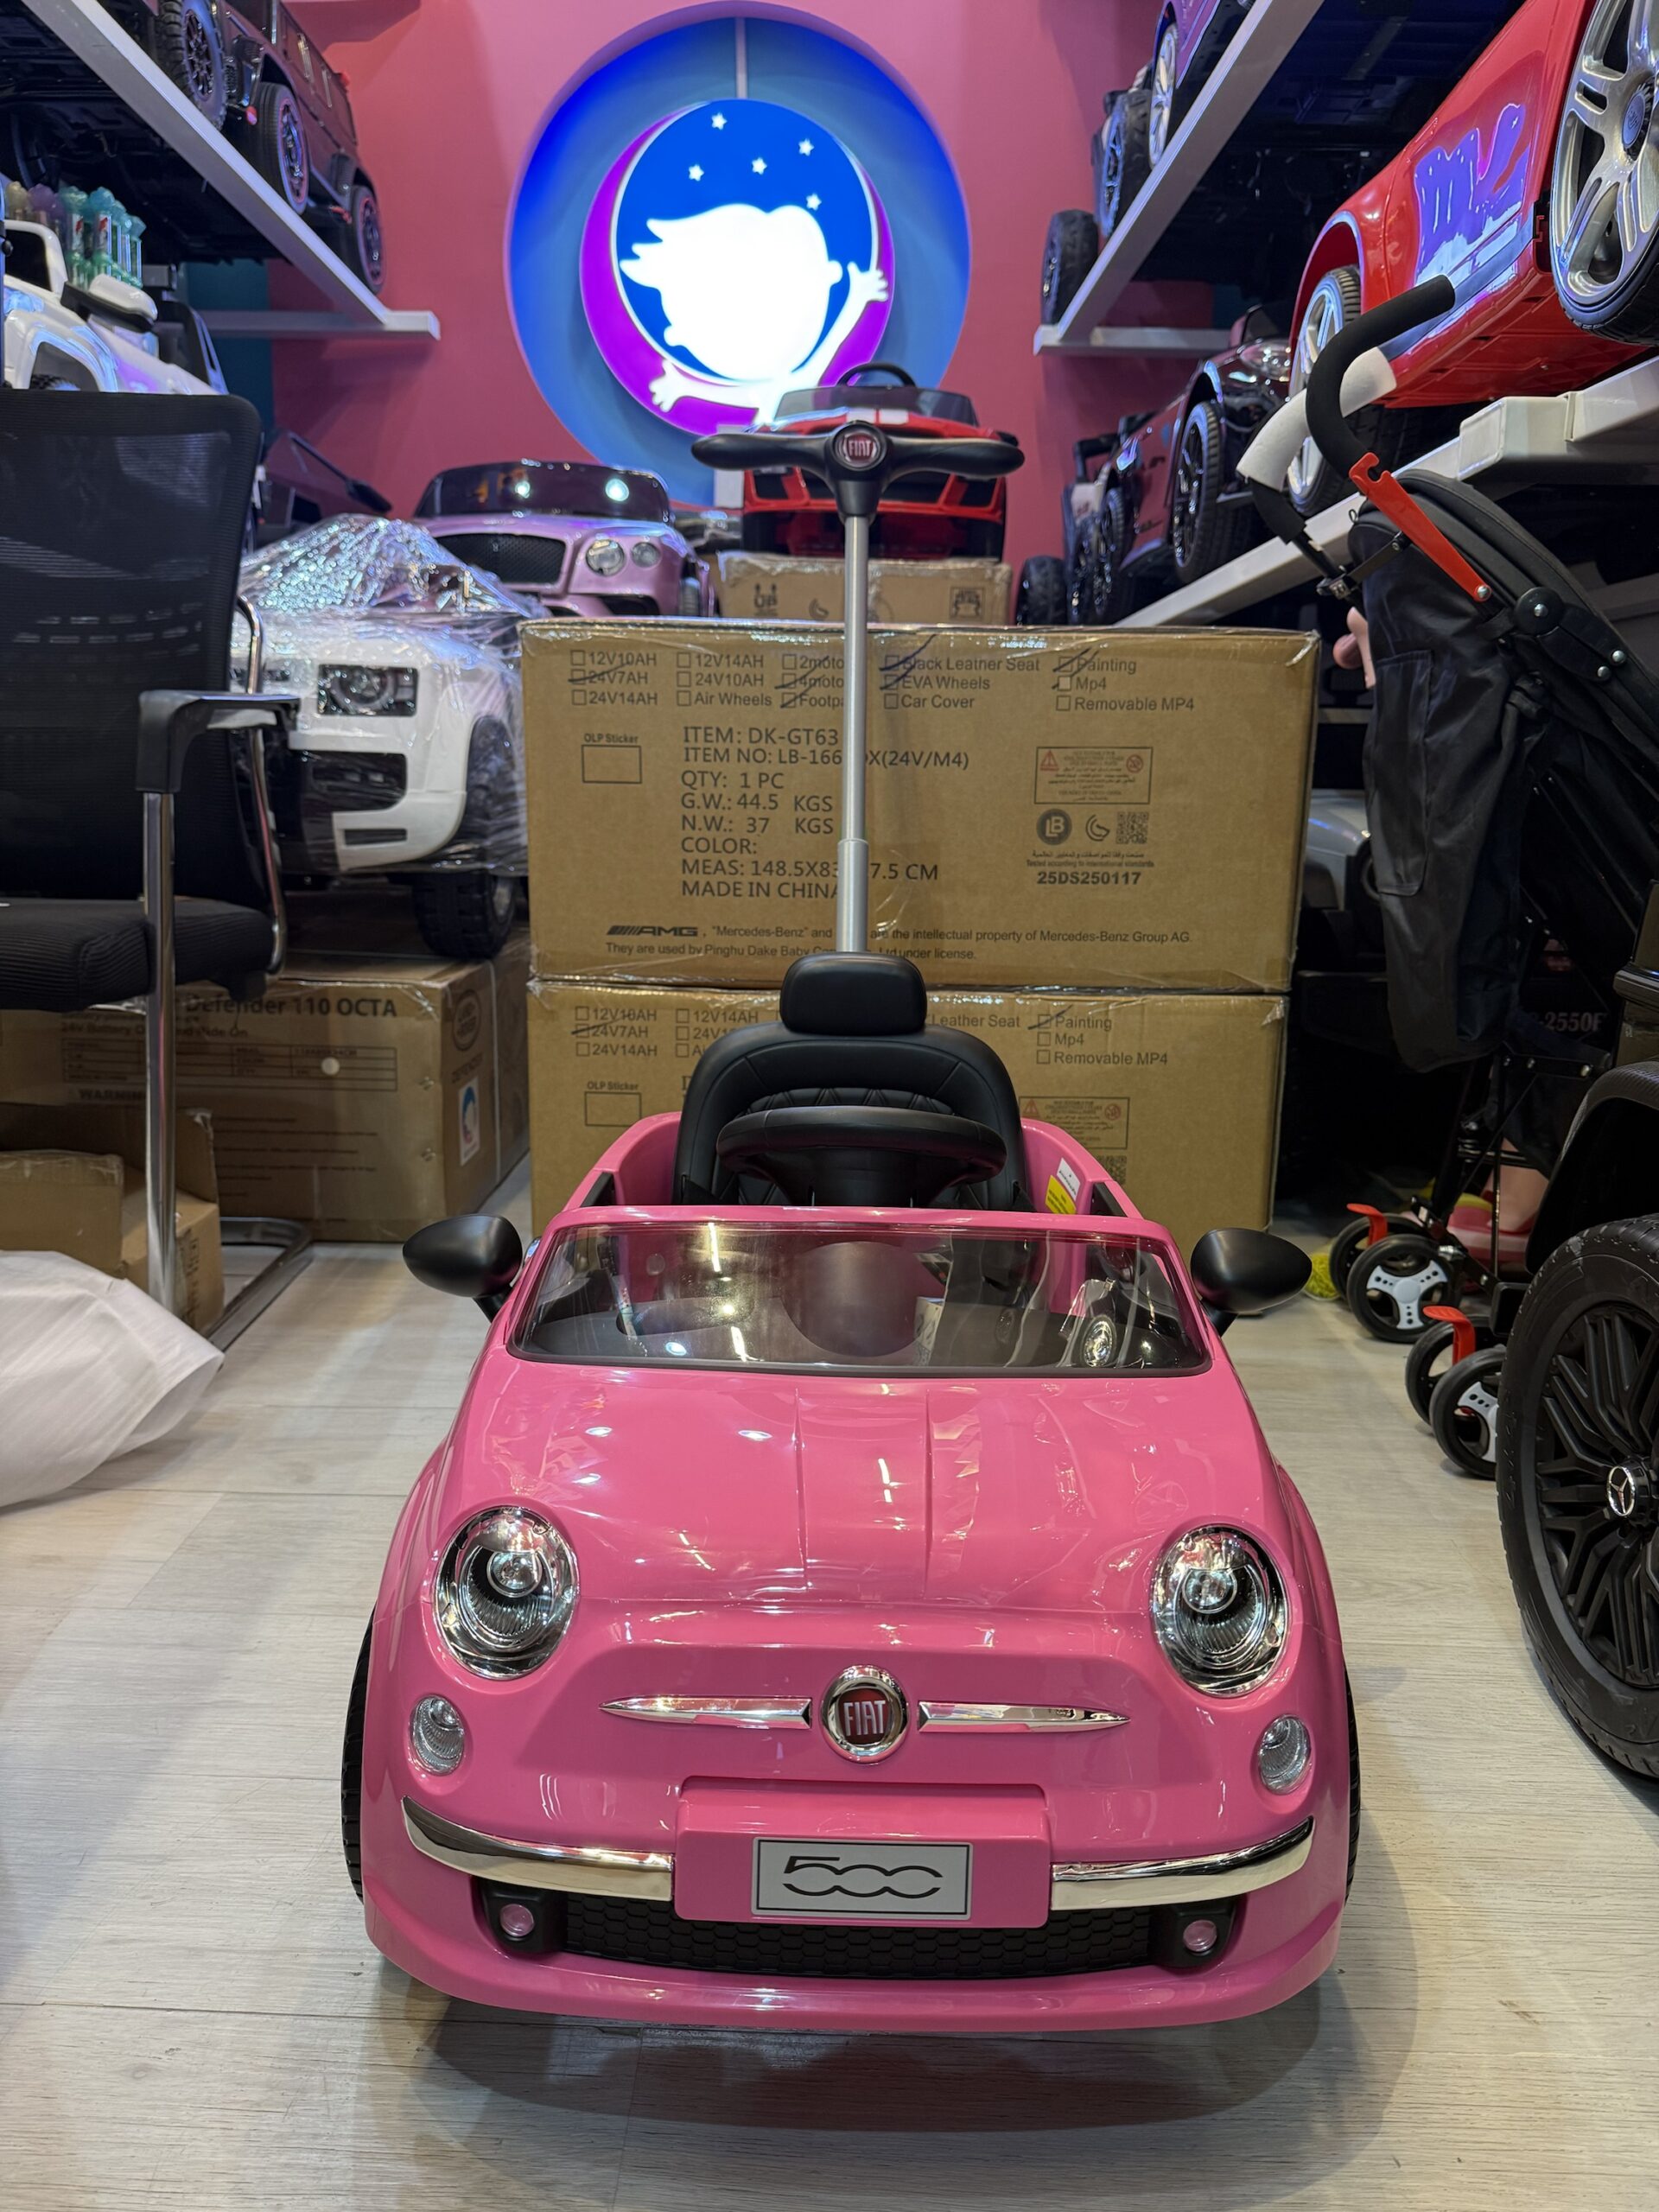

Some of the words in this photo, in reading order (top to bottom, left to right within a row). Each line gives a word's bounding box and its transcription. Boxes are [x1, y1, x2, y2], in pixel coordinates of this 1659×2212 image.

[849, 440, 872, 456] FIAT
[589, 651, 657, 665] 12V10AH
[696, 654, 764, 668] 12V14AH
[799, 656, 844, 670] 2moto
[1006, 658, 1039, 671] Seat
[588, 671, 648, 684] 24V7AH
[696, 673, 764, 687] 24V10AH
[799, 676, 844, 689] 4moto
[902, 675, 932, 690] EVA
[937, 676, 990, 690] Wheels
[1076, 677, 1106, 693] Mp4
[589, 691, 658, 705] 24V14AH
[694, 692, 715, 705] Air
[719, 692, 772, 707] Wheels
[901, 695, 927, 709] Car
[931, 695, 975, 709] Cover
[1075, 696, 1157, 711] Removable
[1161, 697, 1194, 711] MP4
[606, 732, 639, 744] Sticker
[683, 727, 741, 743] ITEM:
[748, 728, 839, 746] DK-GT63
[684, 747, 730, 762] ITEM
[737, 748, 772, 764] NO:
[681, 770, 727, 790] QTY:
[740, 772, 751, 788] 1
[758, 772, 785, 789] PC
[681, 792, 732, 810] G.W.:
[737, 793, 779, 810] 44.5
[794, 795, 833, 812] KGS
[682, 815, 733, 832] N.W.:
[746, 817, 770, 833] 37
[795, 817, 834, 834] KGS
[681, 836, 757, 855] COLOR:
[682, 859, 744, 876] MEAS:
[906, 864, 938, 880] CM
[1037, 871, 1141, 886] 25DS250117
[682, 880, 743, 898] MADE
[748, 881, 771, 898] IN
[810, 928, 833, 938] and
[869, 930, 889, 939] are
[892, 930, 910, 939] the
[912, 929, 973, 940] intellectual
[976, 931, 1022, 943] property
[1025, 930, 1038, 940] of
[1039, 931, 1129, 942] Mercedes-Benz
[1132, 931, 1168, 944] Group
[606, 942, 634, 956] They
[637, 944, 656, 954] are
[658, 944, 686, 955] used
[689, 944, 703, 955] by
[704, 944, 745, 957] Pinghu
[747, 945, 778, 956] Dake
[780, 946, 810, 957] Baby
[900, 949, 931, 959] under
[295, 997, 331, 1015] 110
[336, 998, 398, 1017] OCTA
[592, 1007, 657, 1021] 12V10AH
[694, 1010, 759, 1024] 12V14AH
[931, 1014, 985, 1027] Leather
[988, 1014, 1020, 1028] Seat
[1055, 1015, 1112, 1032] Painting
[592, 1024, 649, 1037] 24V7AH
[1054, 1033, 1084, 1046] Mp4
[592, 1044, 658, 1057] 24V14AH
[1054, 1051, 1133, 1065] Removable
[1137, 1052, 1167, 1065] MP4
[607, 1080, 639, 1090] Sticker
[79, 1090, 146, 1101] WARNIN
[843, 1700, 886, 1737] FIAT
[782, 1855, 943, 1899] 500
